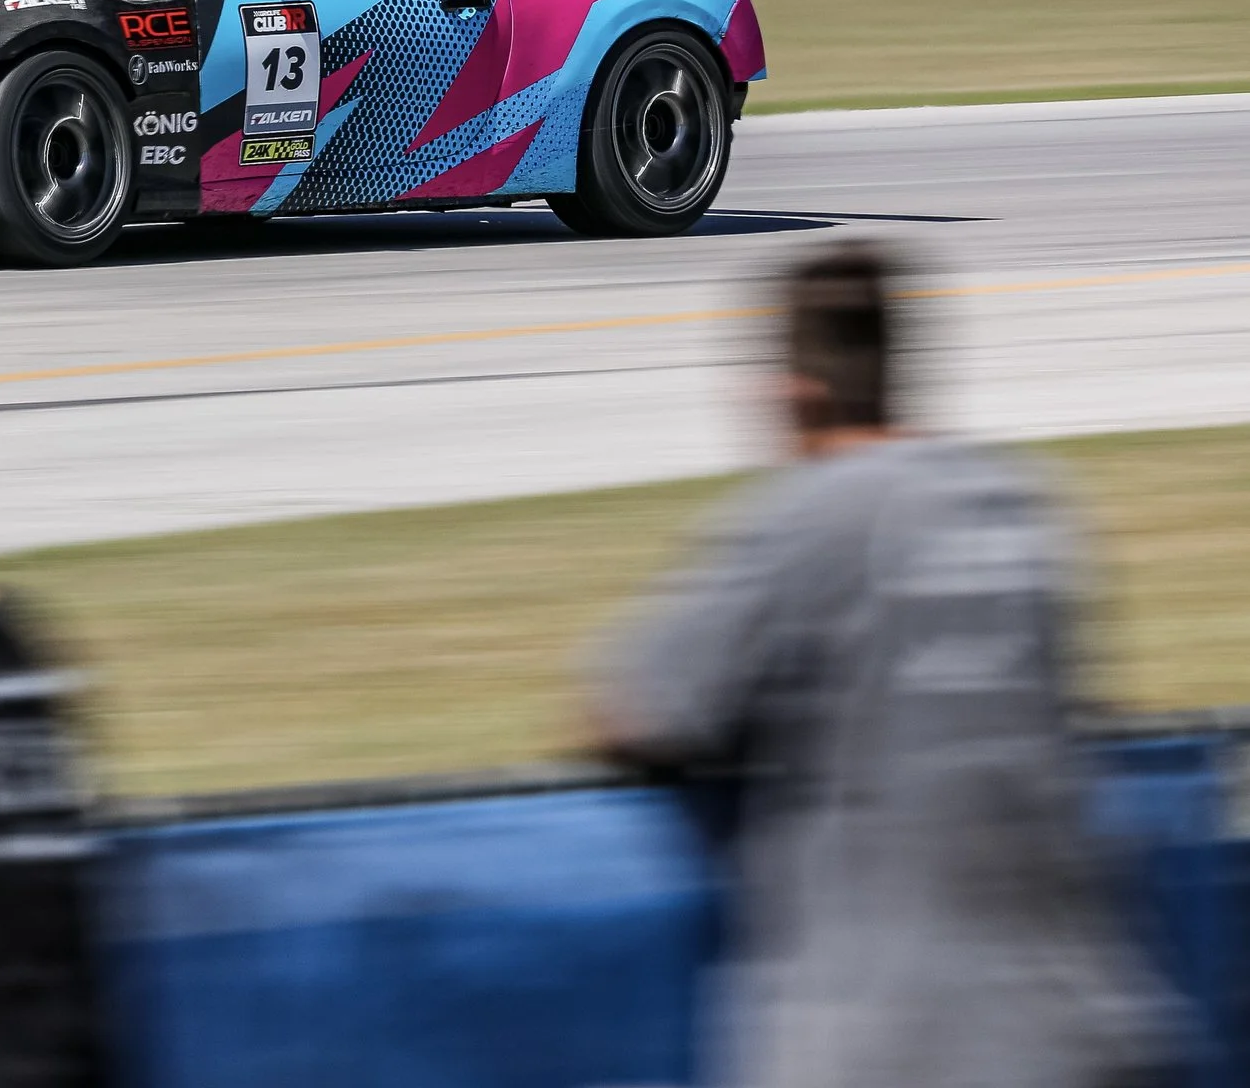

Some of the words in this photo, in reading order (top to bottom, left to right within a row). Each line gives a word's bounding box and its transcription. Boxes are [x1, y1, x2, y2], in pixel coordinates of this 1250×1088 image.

[119, 11, 190, 39] RCE
[147, 59, 199, 74] FabWorks
[261, 45, 306, 91] 13
[250, 110, 312, 125] FALKEN
[246, 143, 273, 158] 24K
[290, 142, 309, 151] GOLD
[293, 149, 311, 158] PASS
[139, 145, 187, 165] EBC
